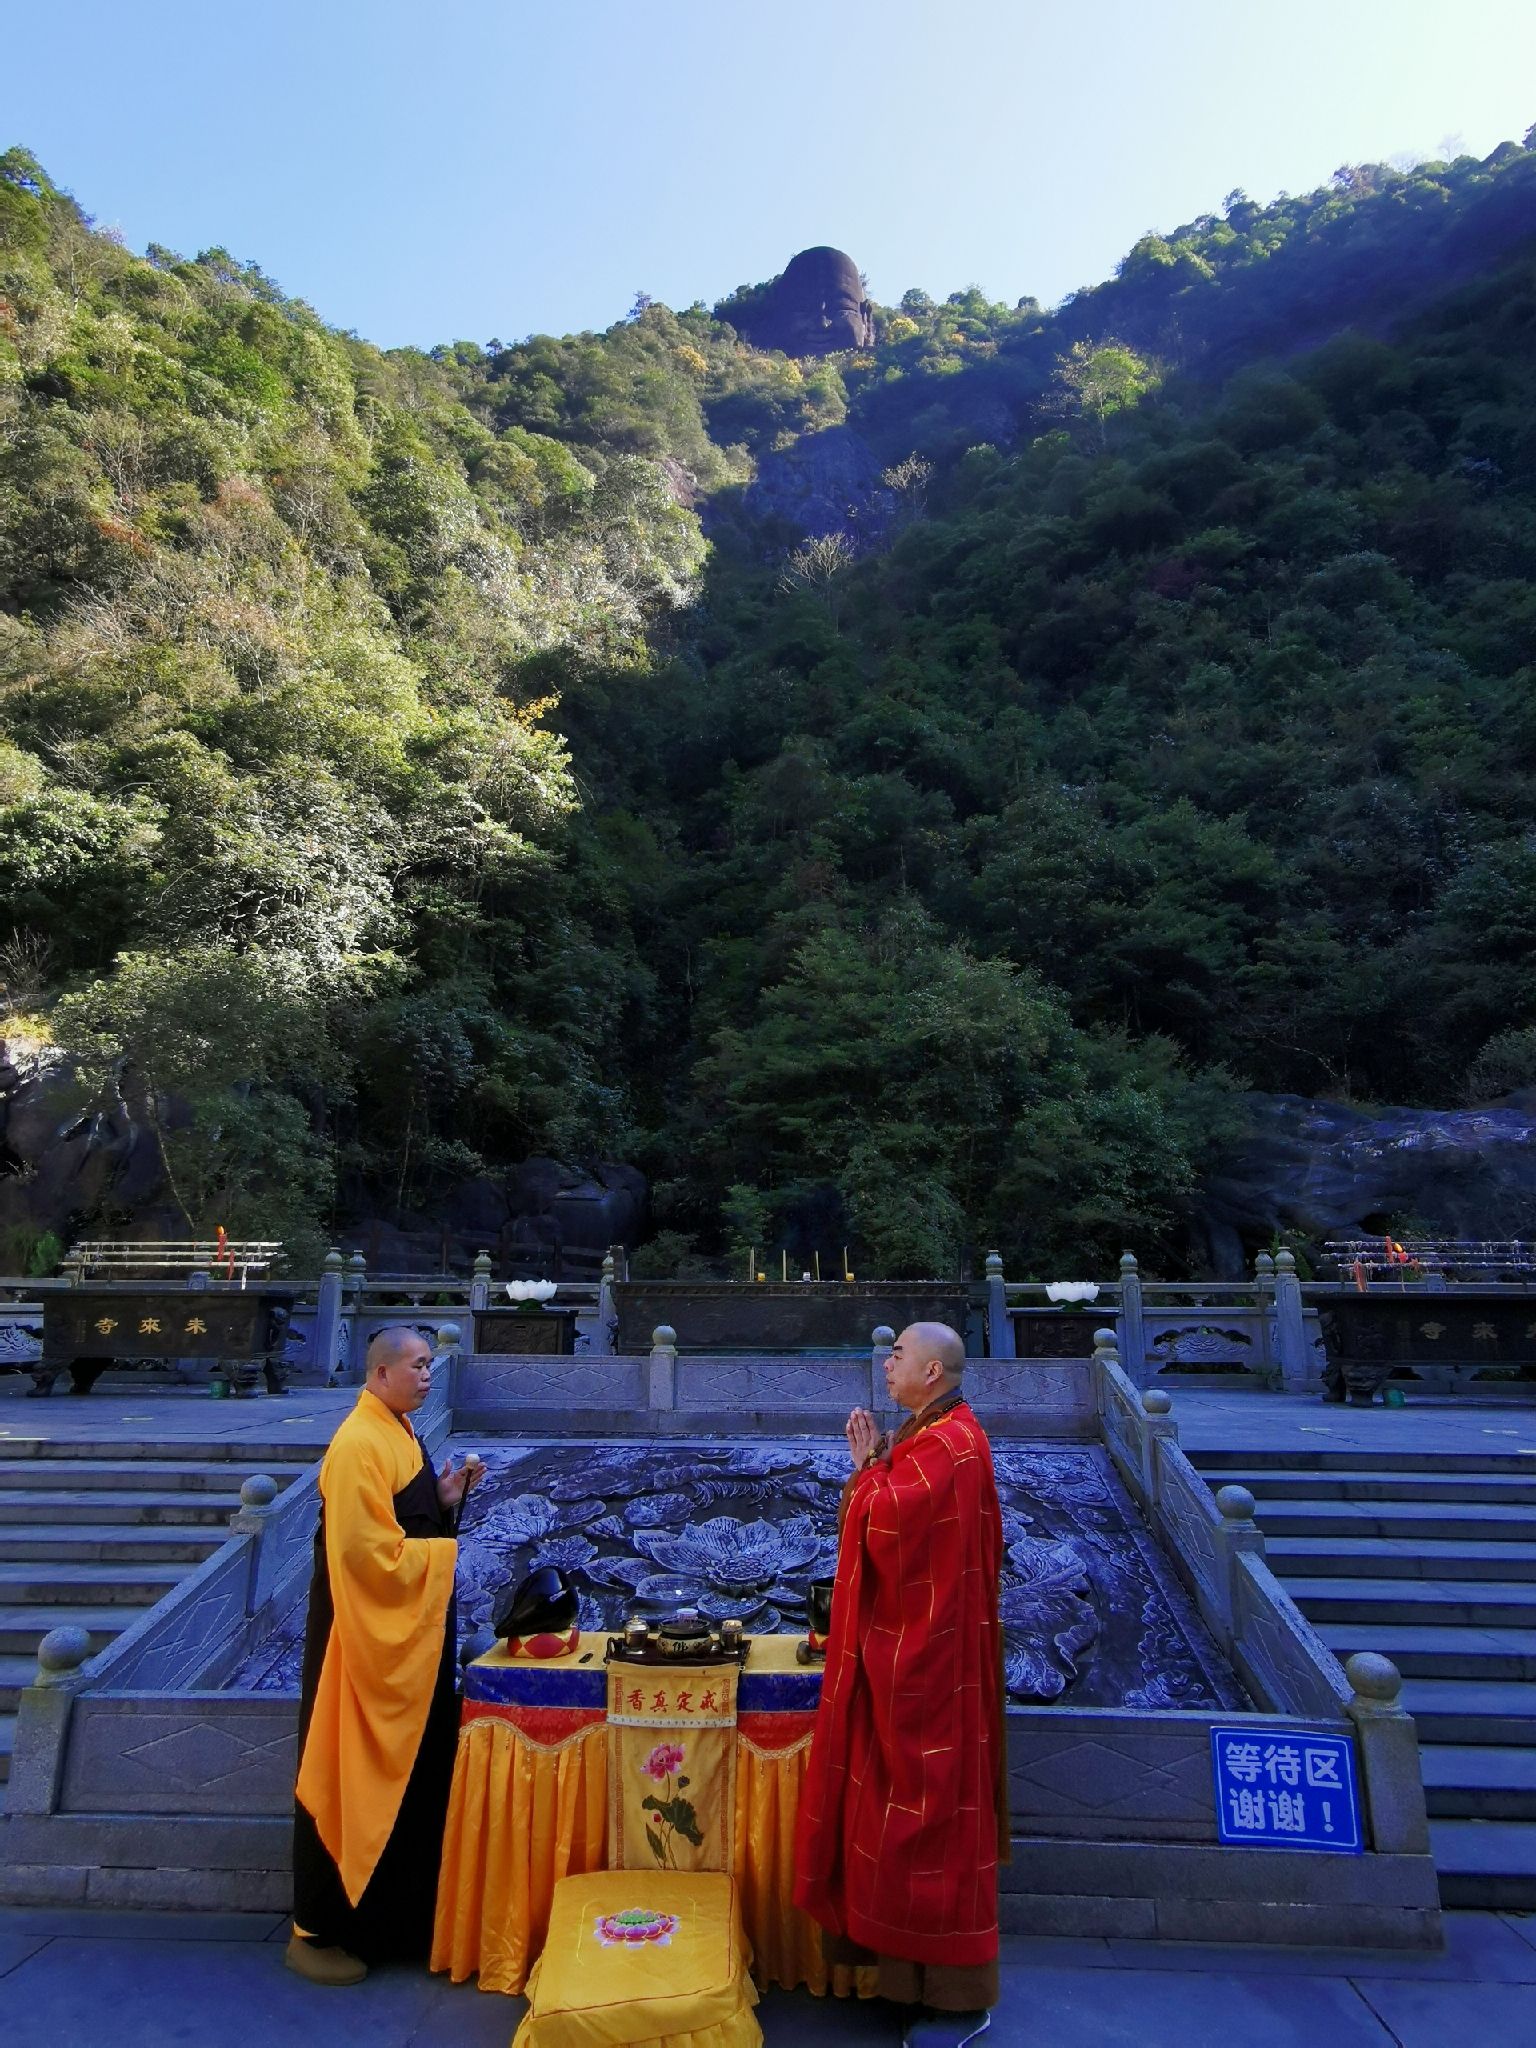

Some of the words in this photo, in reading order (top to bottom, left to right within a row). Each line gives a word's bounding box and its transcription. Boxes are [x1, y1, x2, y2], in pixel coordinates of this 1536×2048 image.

[1225, 1741, 1343, 1789] 等待区
[1229, 1788, 1335, 1833] 谢谢！
